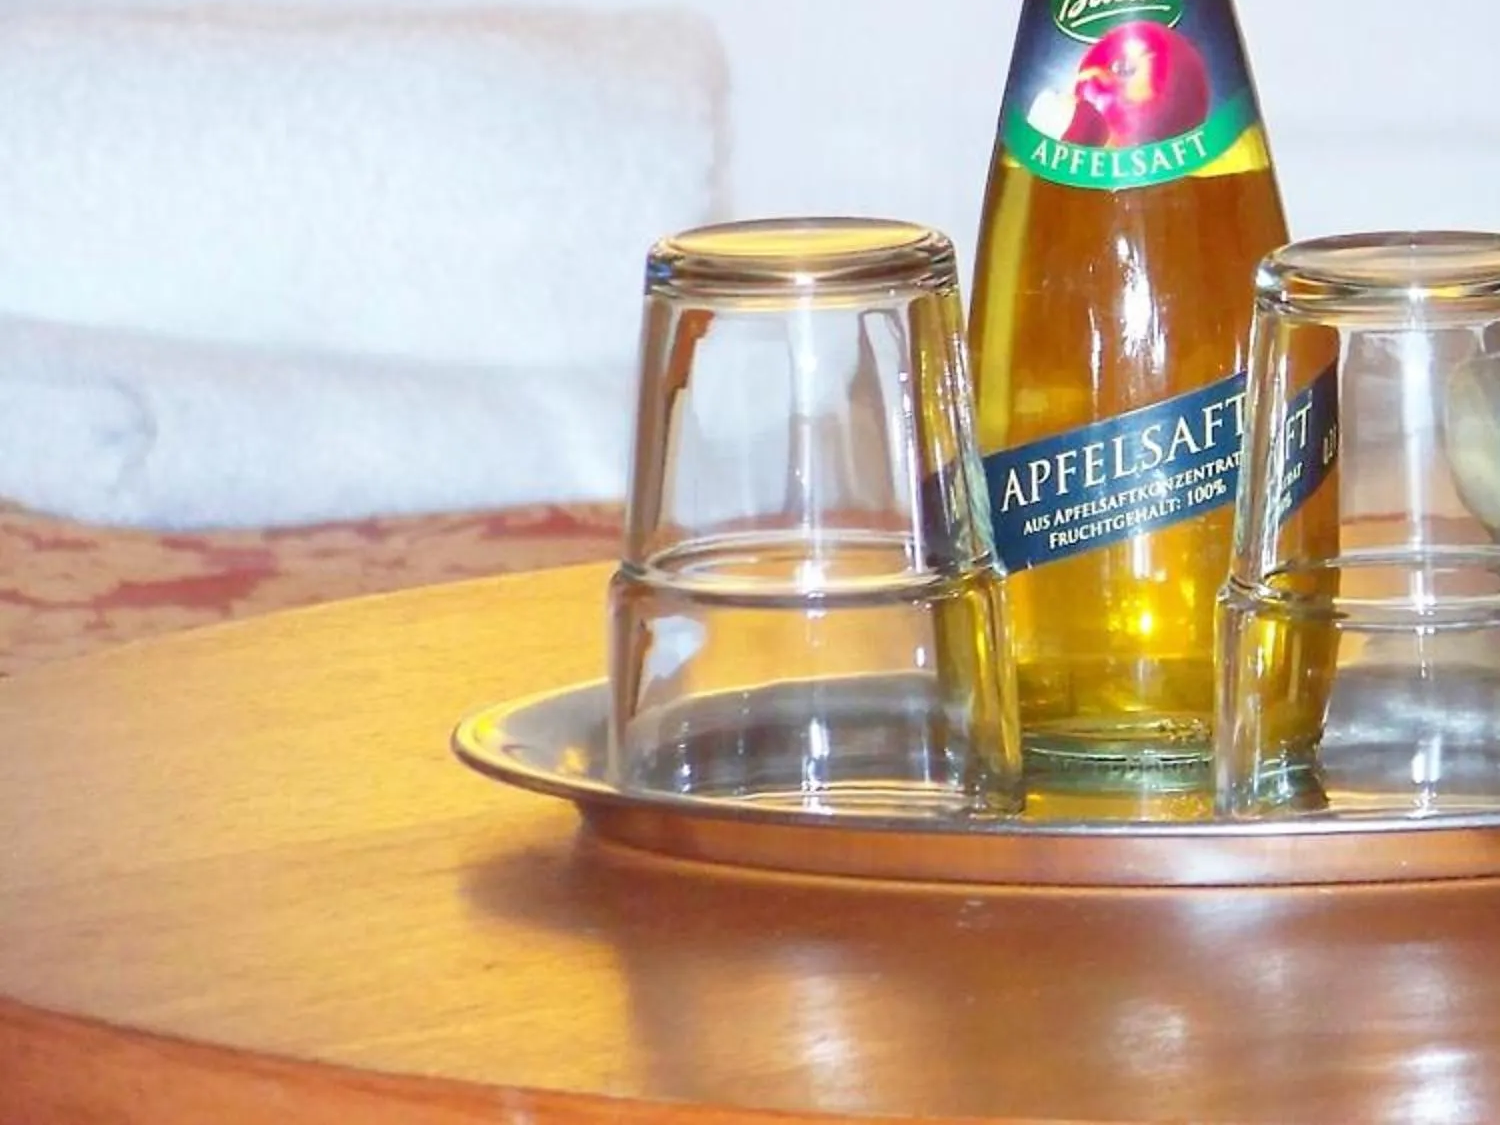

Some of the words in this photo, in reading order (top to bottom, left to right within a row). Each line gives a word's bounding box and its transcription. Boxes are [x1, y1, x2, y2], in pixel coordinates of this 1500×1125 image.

[1031, 131, 1208, 178] APFELSAFT
[1000, 391, 1247, 512] APFELSAFT
[1050, 496, 1182, 550] FRUCHTGEHALT:
[1186, 477, 1228, 507] 100%
